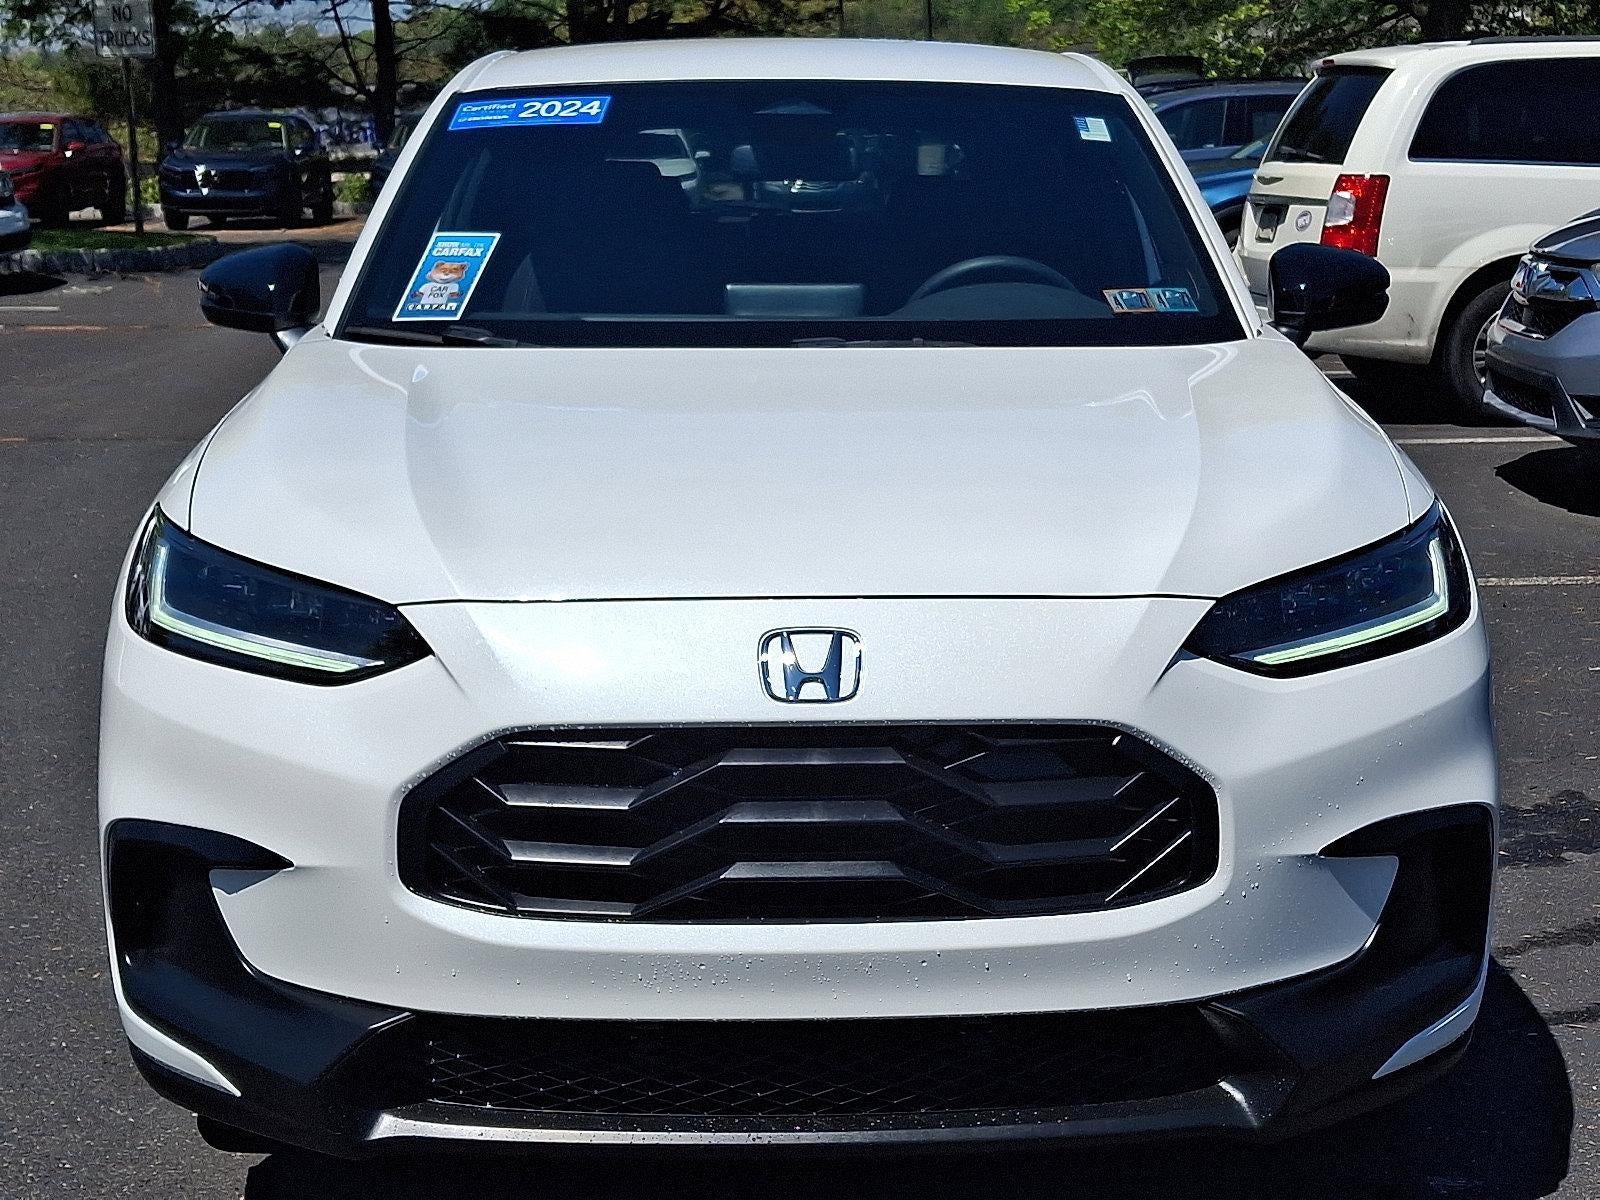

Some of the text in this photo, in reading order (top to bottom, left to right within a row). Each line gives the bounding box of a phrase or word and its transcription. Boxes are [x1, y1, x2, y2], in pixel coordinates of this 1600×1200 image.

[112, 5, 132, 22] NO
[97, 30, 150, 47] TRUCKS
[462, 102, 517, 112] Certified
[518, 100, 602, 118] 2024
[432, 247, 485, 257] CARFAX
[430, 285, 449, 293] CAR
